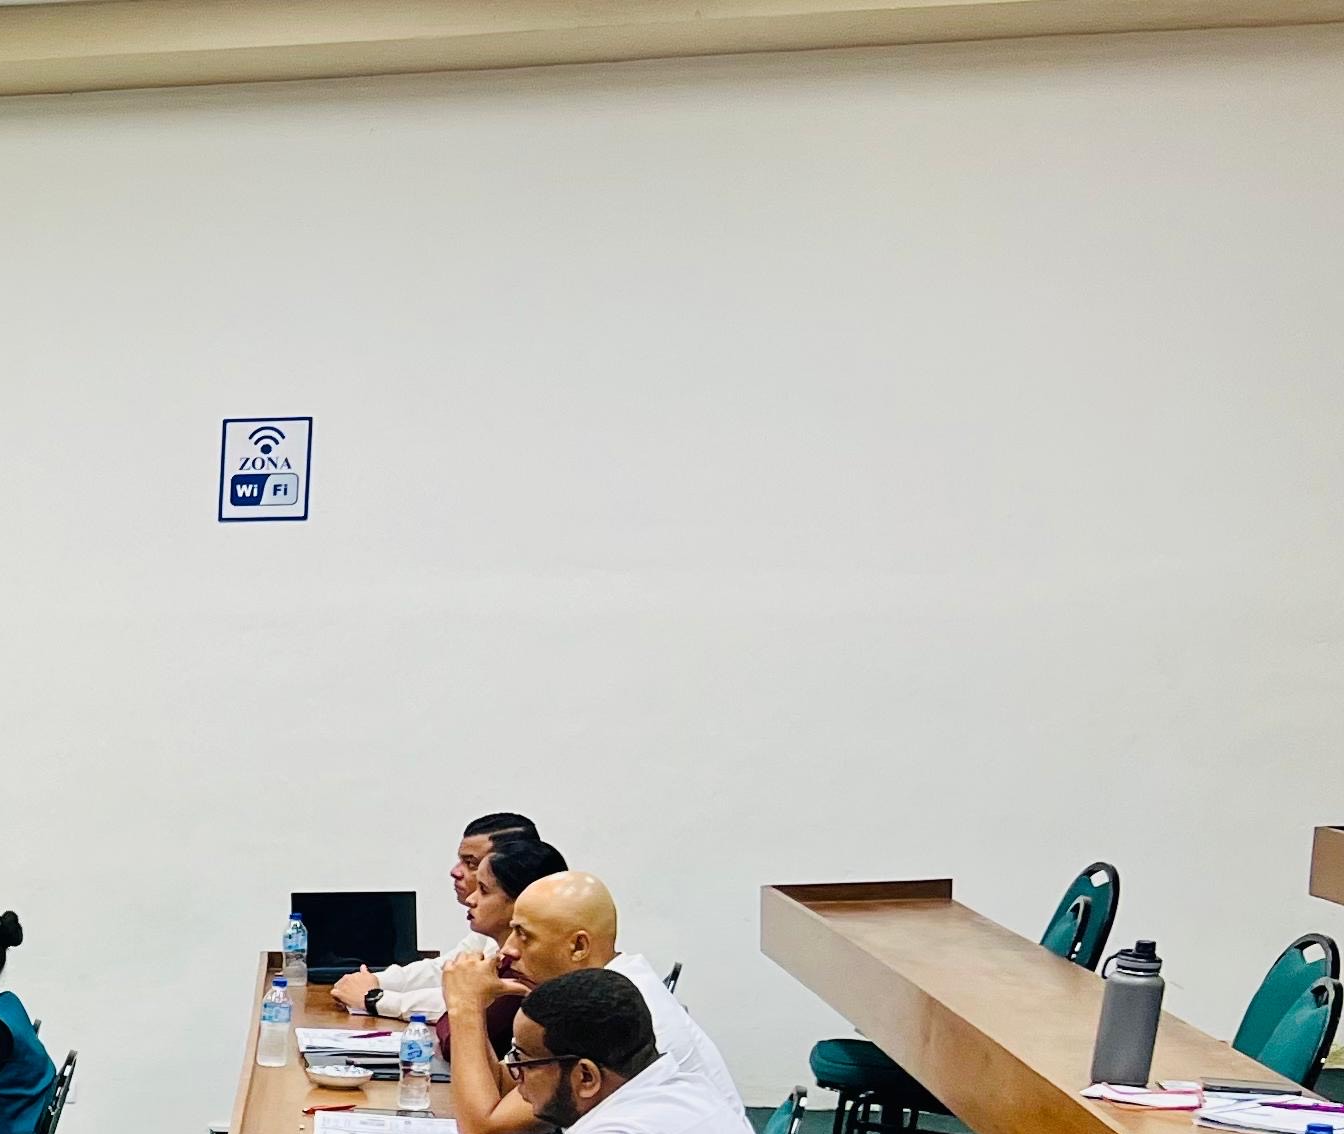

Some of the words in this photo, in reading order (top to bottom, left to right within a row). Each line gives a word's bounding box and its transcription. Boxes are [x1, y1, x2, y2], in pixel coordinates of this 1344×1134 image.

[238, 457, 292, 471] ZONA
[236, 484, 258, 498] Wi
[272, 483, 288, 497] Fi
